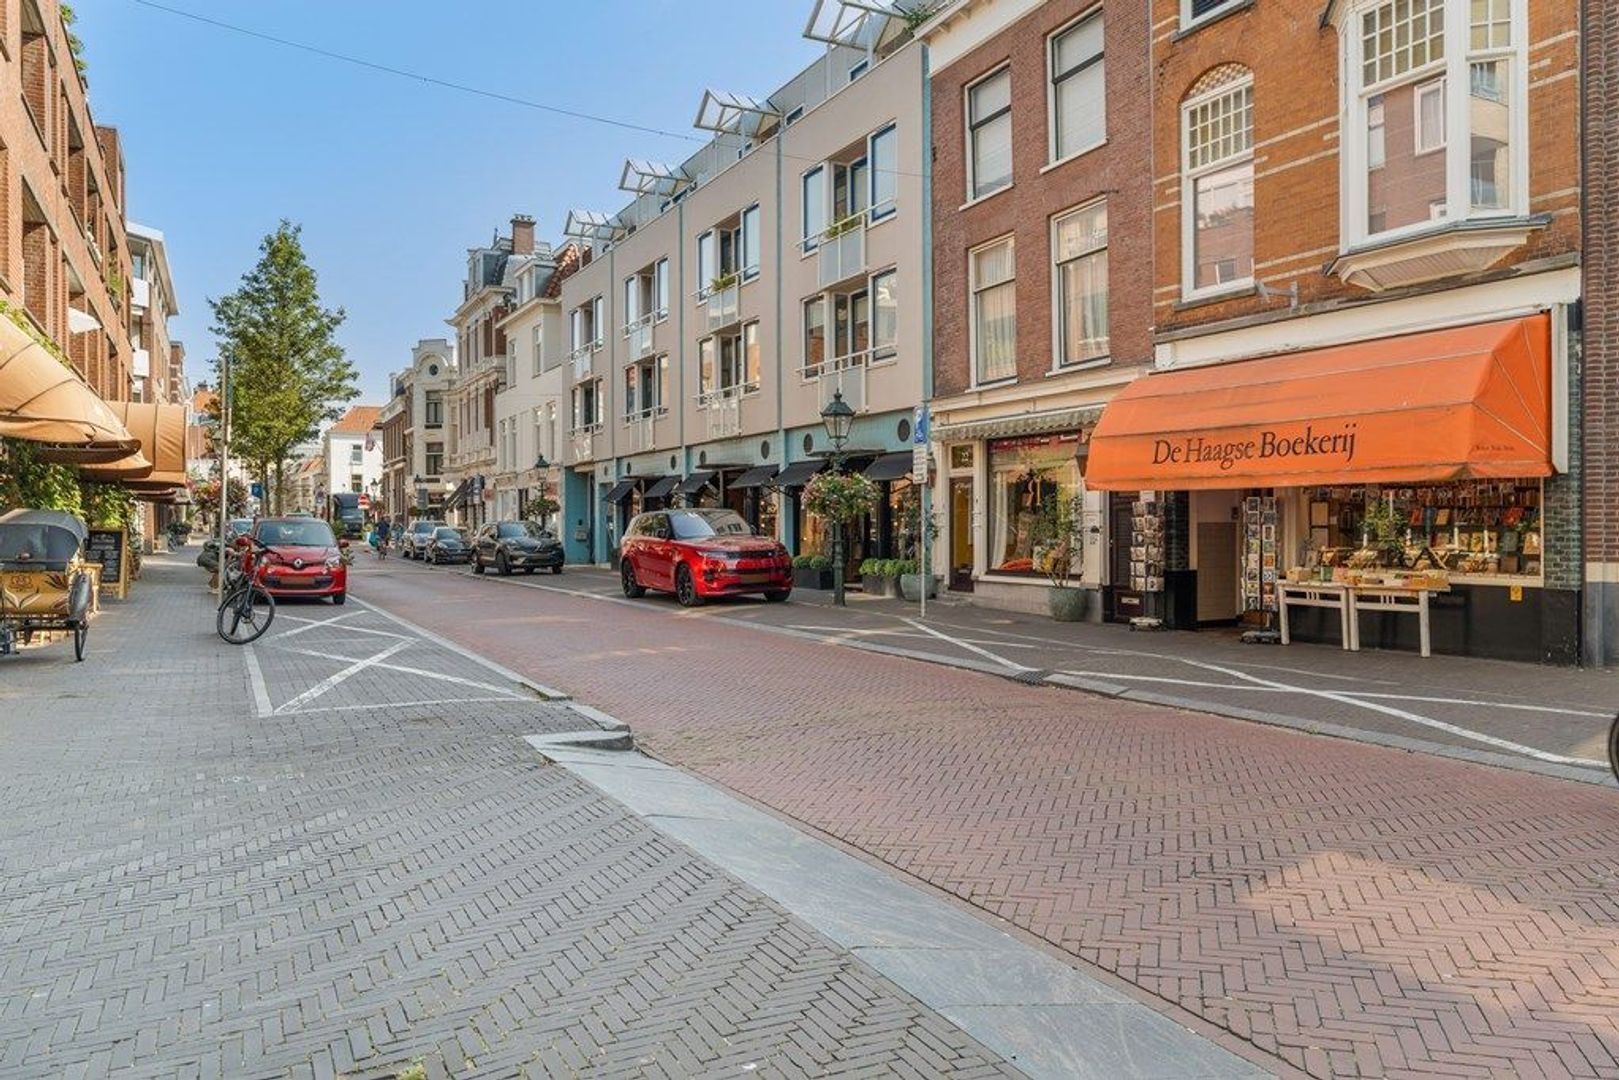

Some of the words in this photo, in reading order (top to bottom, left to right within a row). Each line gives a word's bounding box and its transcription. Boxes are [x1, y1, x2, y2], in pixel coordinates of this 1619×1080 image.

[1152, 439, 1182, 465] De
[1185, 438, 1255, 470] Haagse
[1259, 423, 1357, 462] Boekerij
